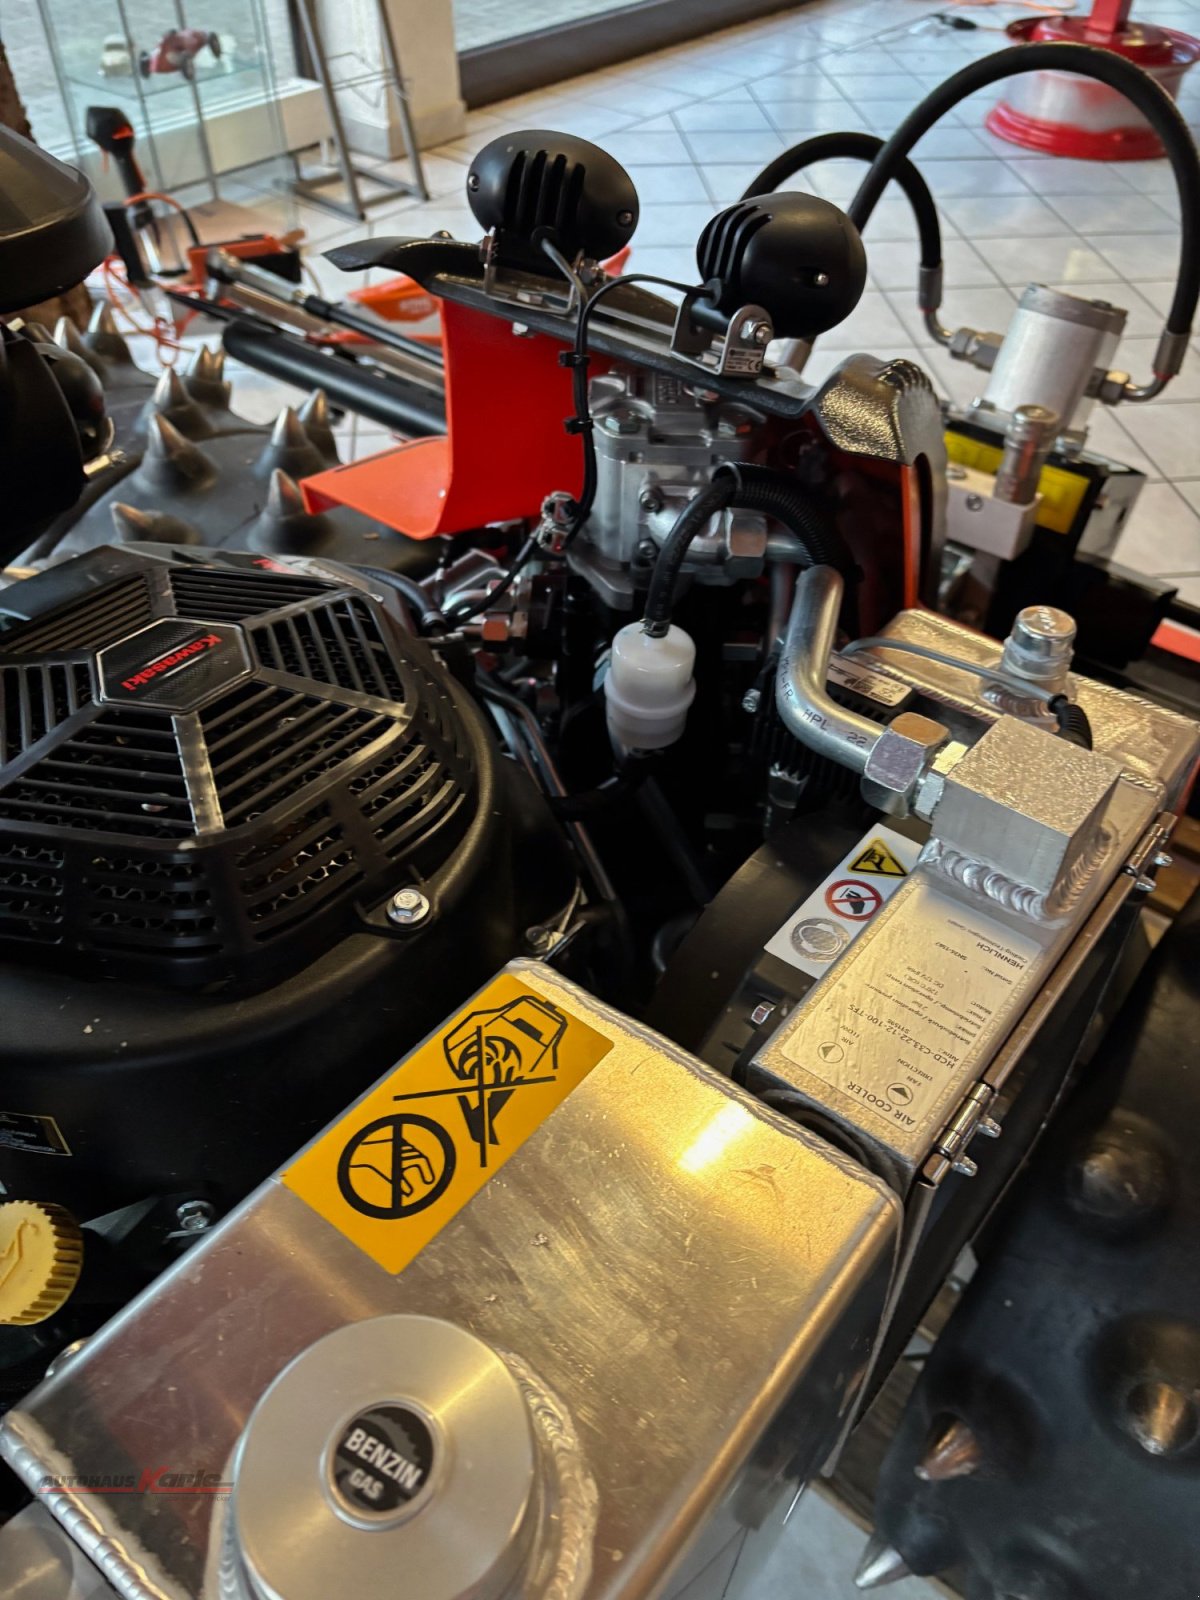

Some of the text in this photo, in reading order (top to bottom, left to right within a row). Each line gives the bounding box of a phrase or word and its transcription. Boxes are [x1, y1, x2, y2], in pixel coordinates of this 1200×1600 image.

[120, 633, 223, 691] Kawasaki
[802, 708, 828, 731] HPL
[975, 941, 1024, 970] HENNLICH
[840, 1036, 854, 1046] AIR
[896, 1057, 933, 1081] DIRECTION
[905, 1074, 922, 1086] FAN
[845, 1080, 915, 1127] AIR COOLER
[344, 1427, 423, 1490] BENZIN
[348, 1468, 384, 1500] GAS
